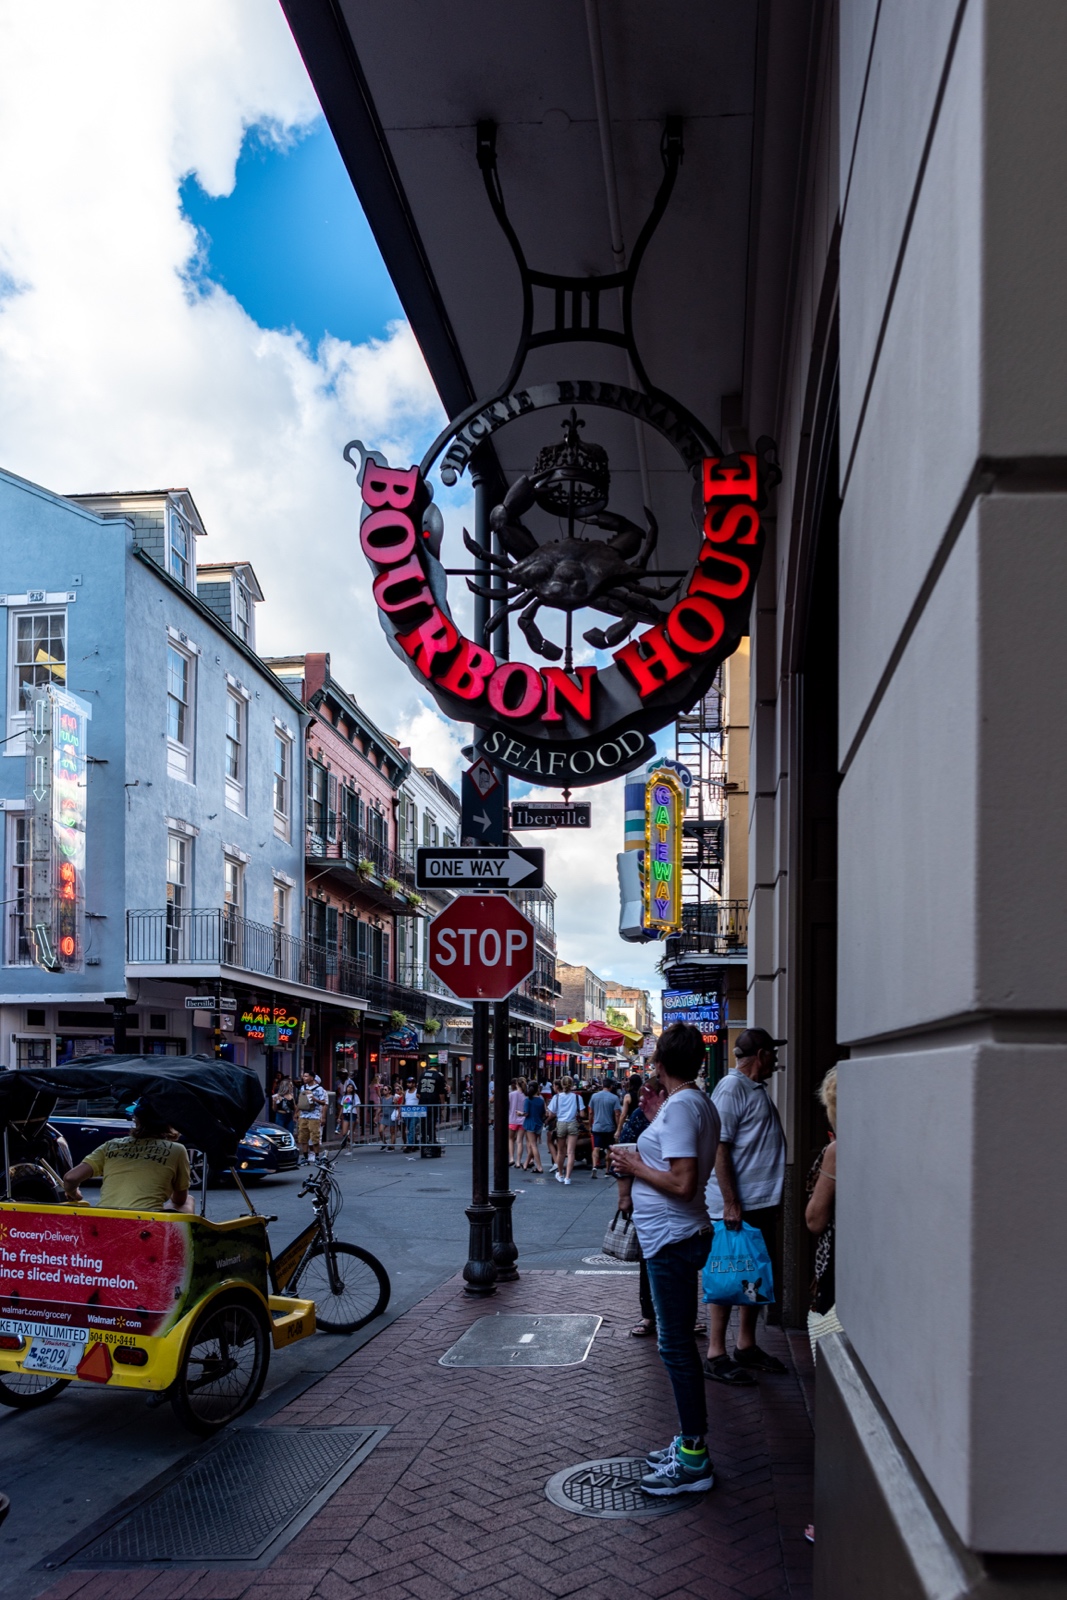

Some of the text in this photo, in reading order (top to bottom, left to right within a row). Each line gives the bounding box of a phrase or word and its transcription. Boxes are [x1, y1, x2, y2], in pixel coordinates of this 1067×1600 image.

[446, 391, 534, 467] DICKIE
[360, 454, 761, 722] BOURBON HOUSE
[483, 729, 646, 776] SEAFOOD
[517, 811, 586, 825] Iberville
[653, 786, 673, 919] GATEWAY
[430, 860, 505, 876] ONE WAY
[435, 927, 528, 967] STOP
[187, 1000, 214, 1008] Iberville
[420, 1078, 436, 1093] 25
[9, 1227, 79, 1246] GroceryDelivery
[19, 1249, 68, 1266] freshest
[71, 1254, 103, 1273] thing
[215, 1254, 241, 1269] Walmart
[710, 1259, 754, 1273] PLACE
[0, 1264, 138, 1290] ince sliced watermelon.
[2, 1306, 72, 1322] walmart.com/grocery
[87, 1314, 116, 1325] Walmart
[12, 1321, 32, 1336] TAXI
[34, 1324, 87, 1341] UNLIMITED
[90, 1332, 136, 1346] 504 891-3441
[36, 1355, 49, 1364] NC
[49, 1348, 65, 1363] 09
